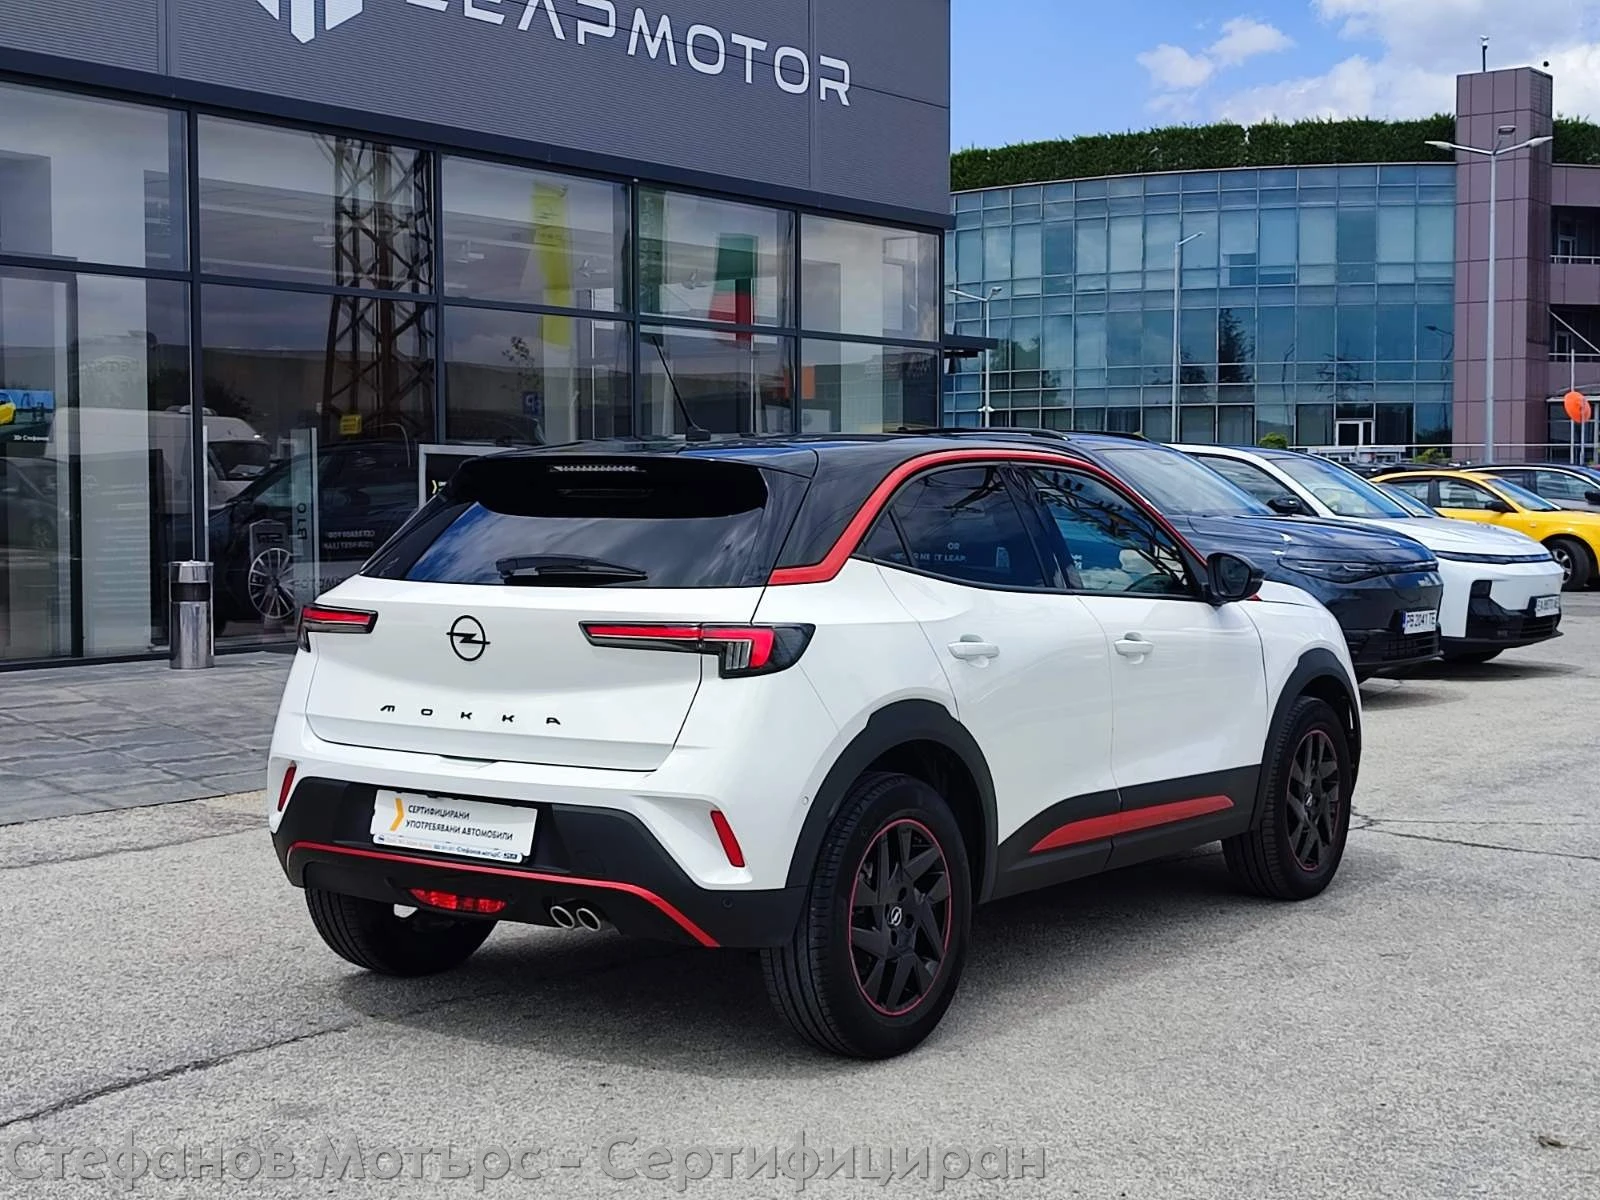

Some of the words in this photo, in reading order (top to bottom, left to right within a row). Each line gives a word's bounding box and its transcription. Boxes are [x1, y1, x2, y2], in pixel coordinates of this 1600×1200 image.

[405, 0, 850, 106] APMOTOR
[380, 704, 561, 725] MOKKA
[408, 804, 470, 820] СЕРТИФИЦИРАНИ
[405, 819, 461, 835] УПОТРЕБЯВАНИ
[462, 828, 513, 841] АВТОМОБИЛИ
